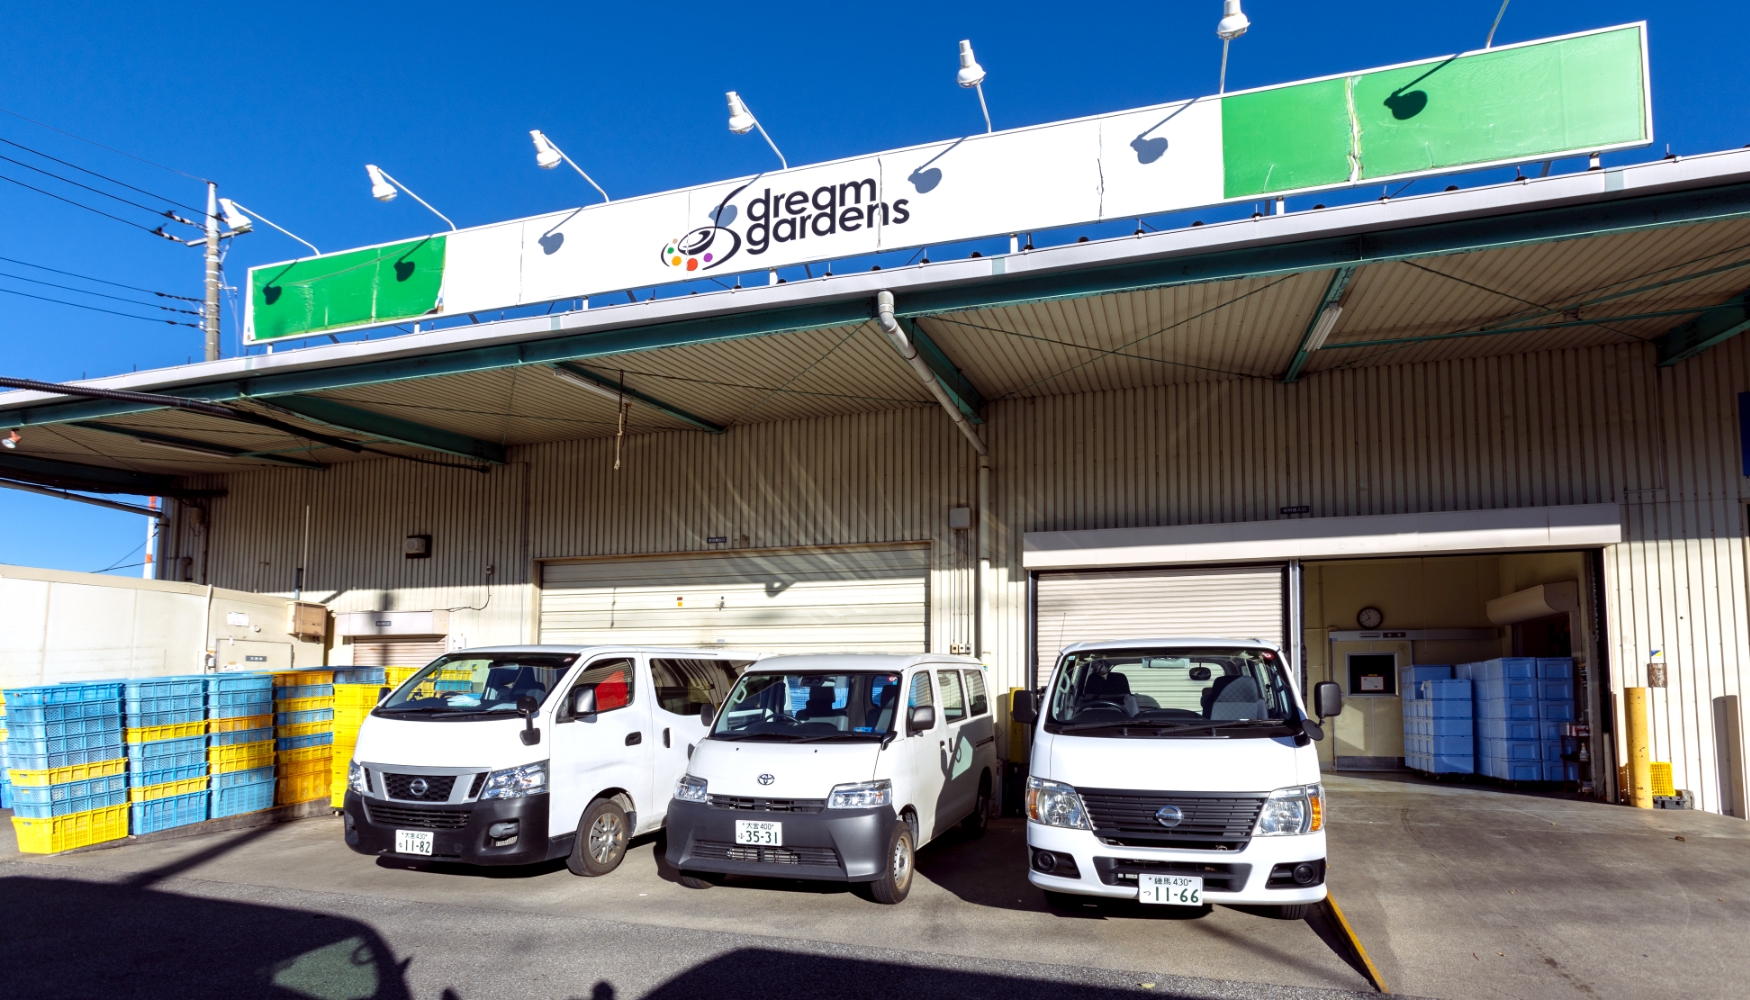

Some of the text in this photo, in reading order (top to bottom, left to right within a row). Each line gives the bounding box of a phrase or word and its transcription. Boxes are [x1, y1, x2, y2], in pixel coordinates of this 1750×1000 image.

[747, 177, 877, 222] dream
[746, 198, 910, 255] gardens
[746, 822, 760, 830] 大宮
[745, 830, 778, 844] 35-31
[405, 840, 431, 853] 11-82
[1154, 877, 1189, 886] 練馬 430
[1155, 886, 1199, 903] 11-66
